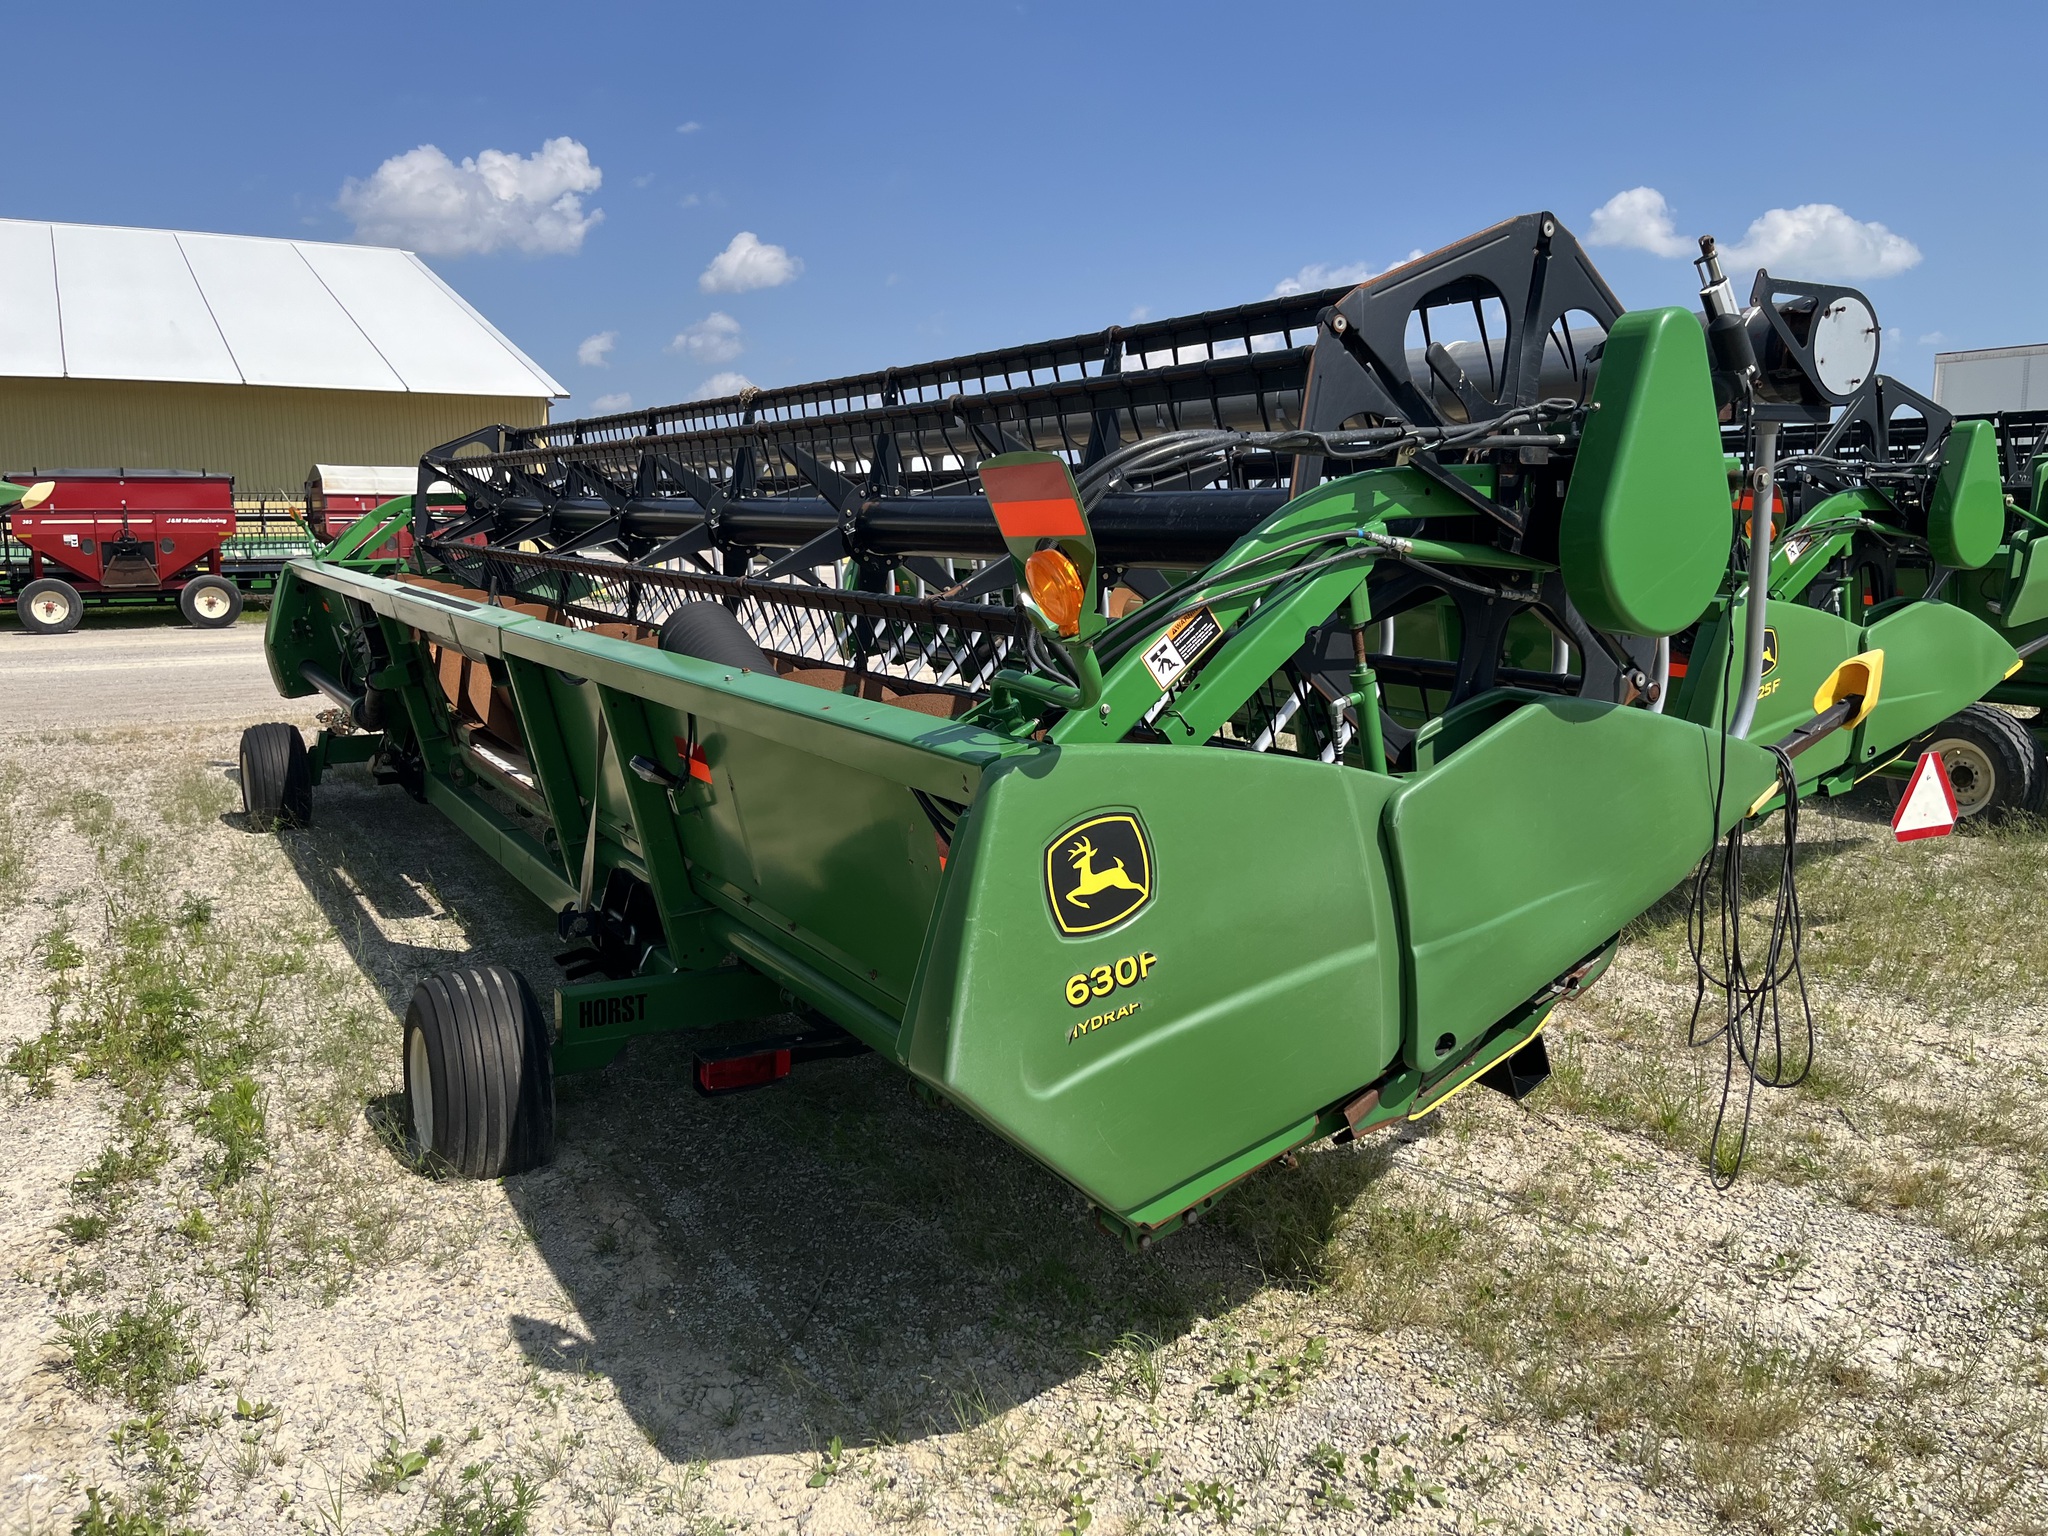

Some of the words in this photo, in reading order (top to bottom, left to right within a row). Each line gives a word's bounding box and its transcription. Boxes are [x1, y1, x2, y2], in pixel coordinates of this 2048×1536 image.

[1756, 678, 1781, 700] 25F
[1065, 951, 1157, 1008] 630F
[579, 993, 648, 1028] HORST
